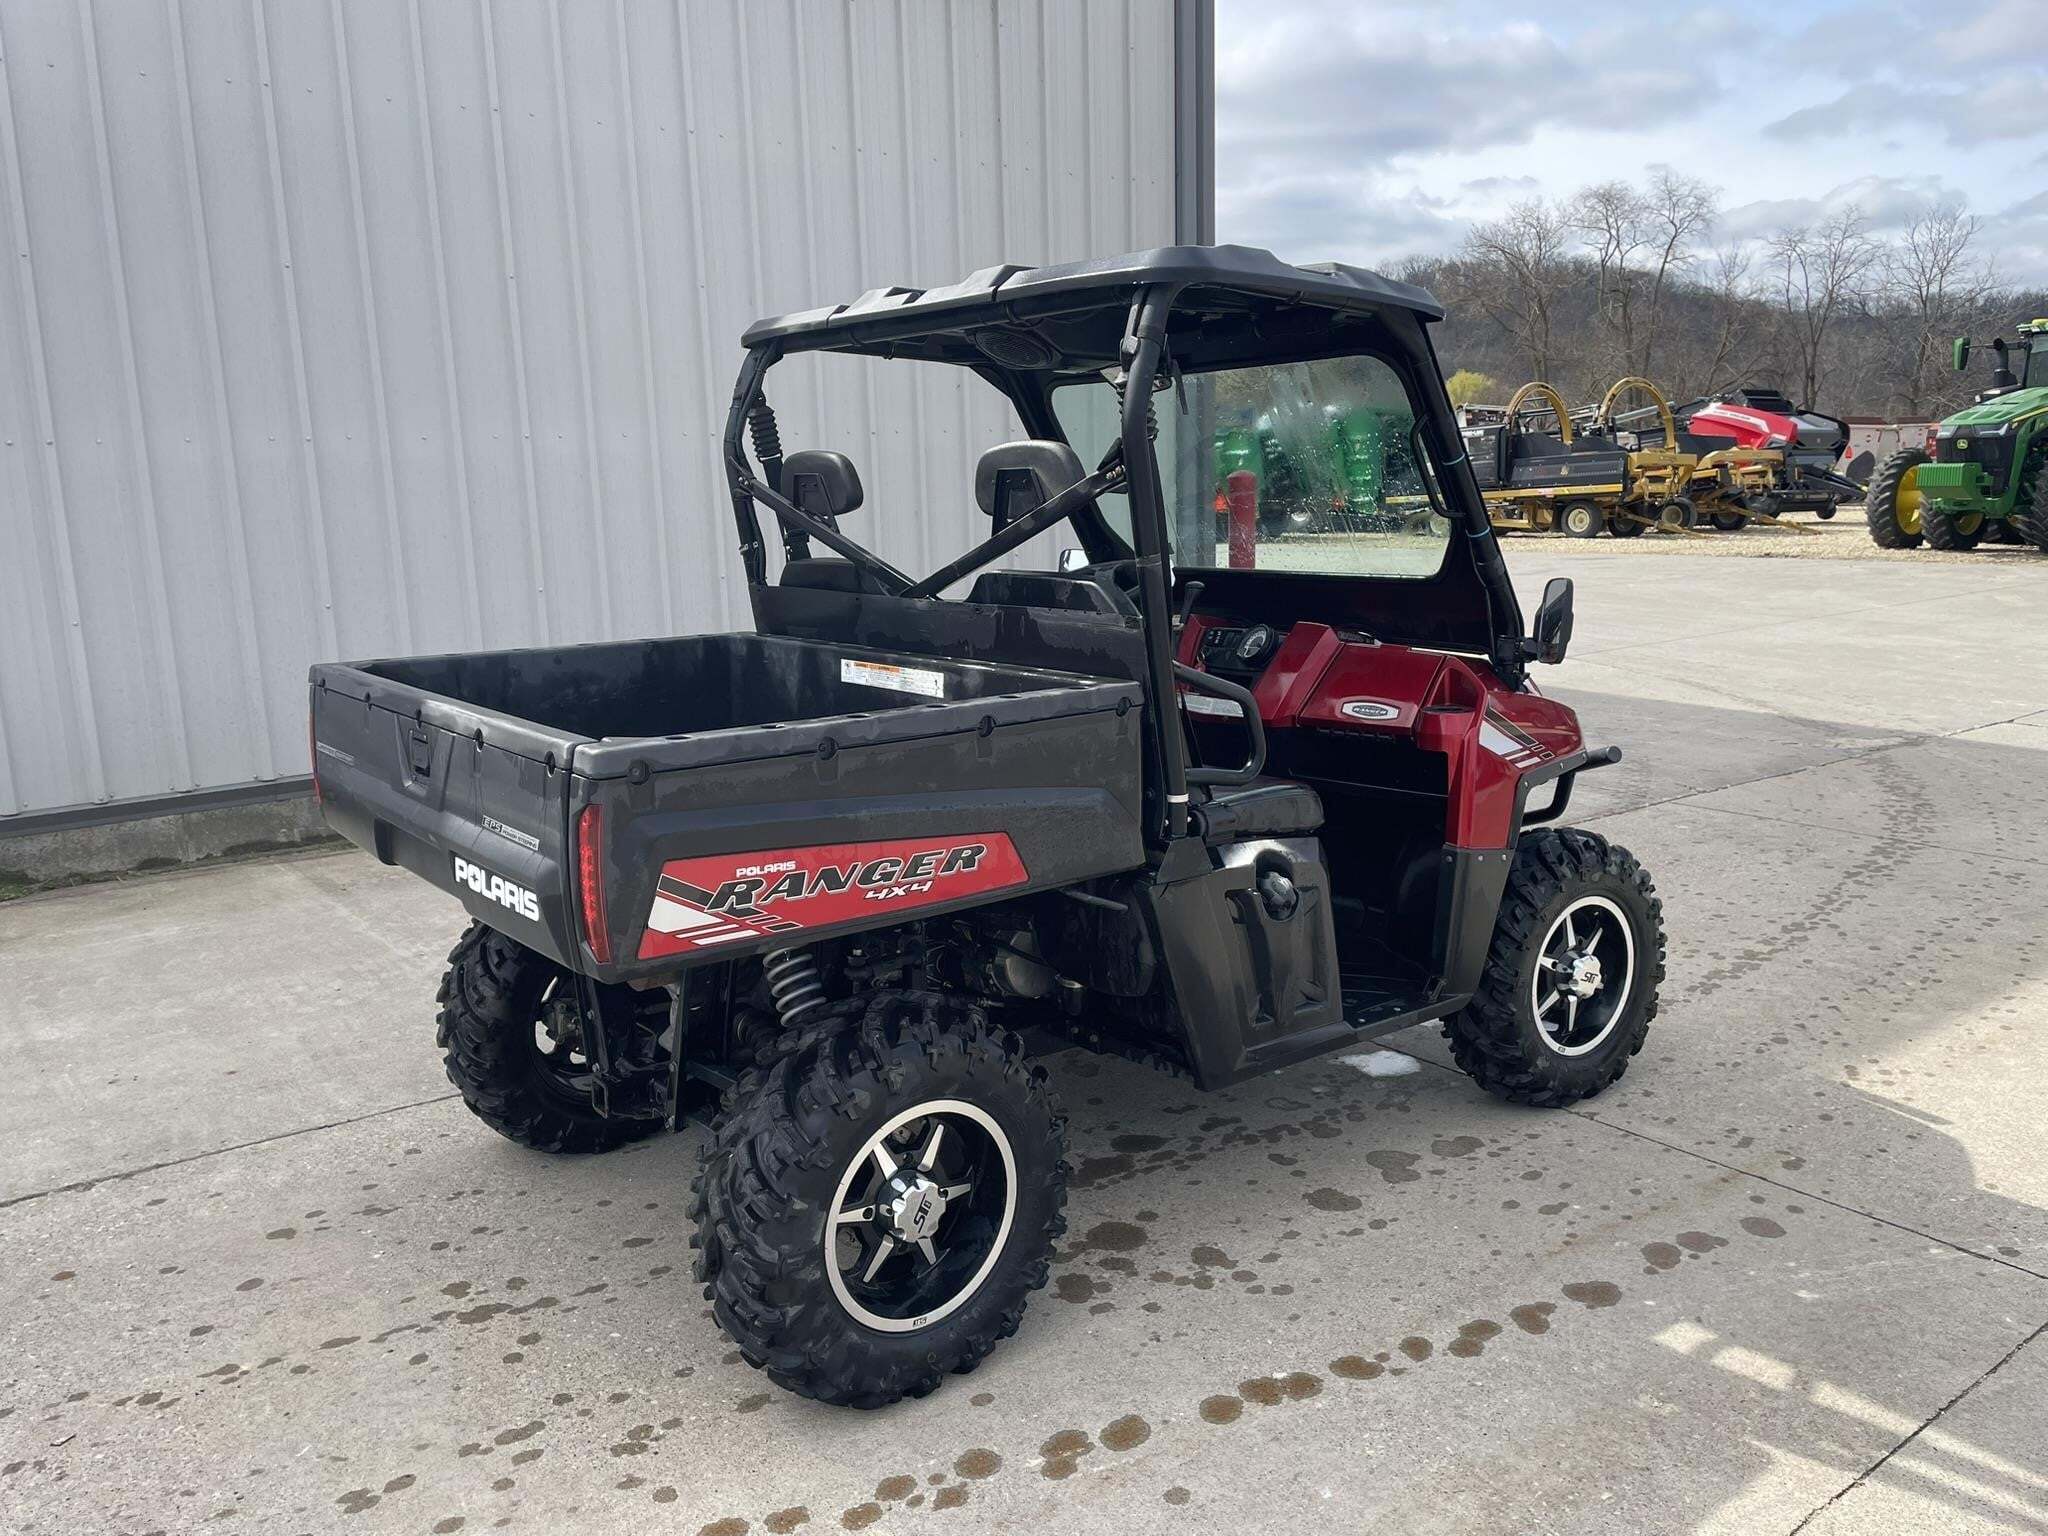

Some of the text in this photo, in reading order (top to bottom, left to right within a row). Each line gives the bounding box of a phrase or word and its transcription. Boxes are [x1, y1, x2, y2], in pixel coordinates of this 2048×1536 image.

[454, 856, 540, 922] POLARIS
[704, 843, 987, 912] RANGER
[735, 860, 797, 878] POLARIS
